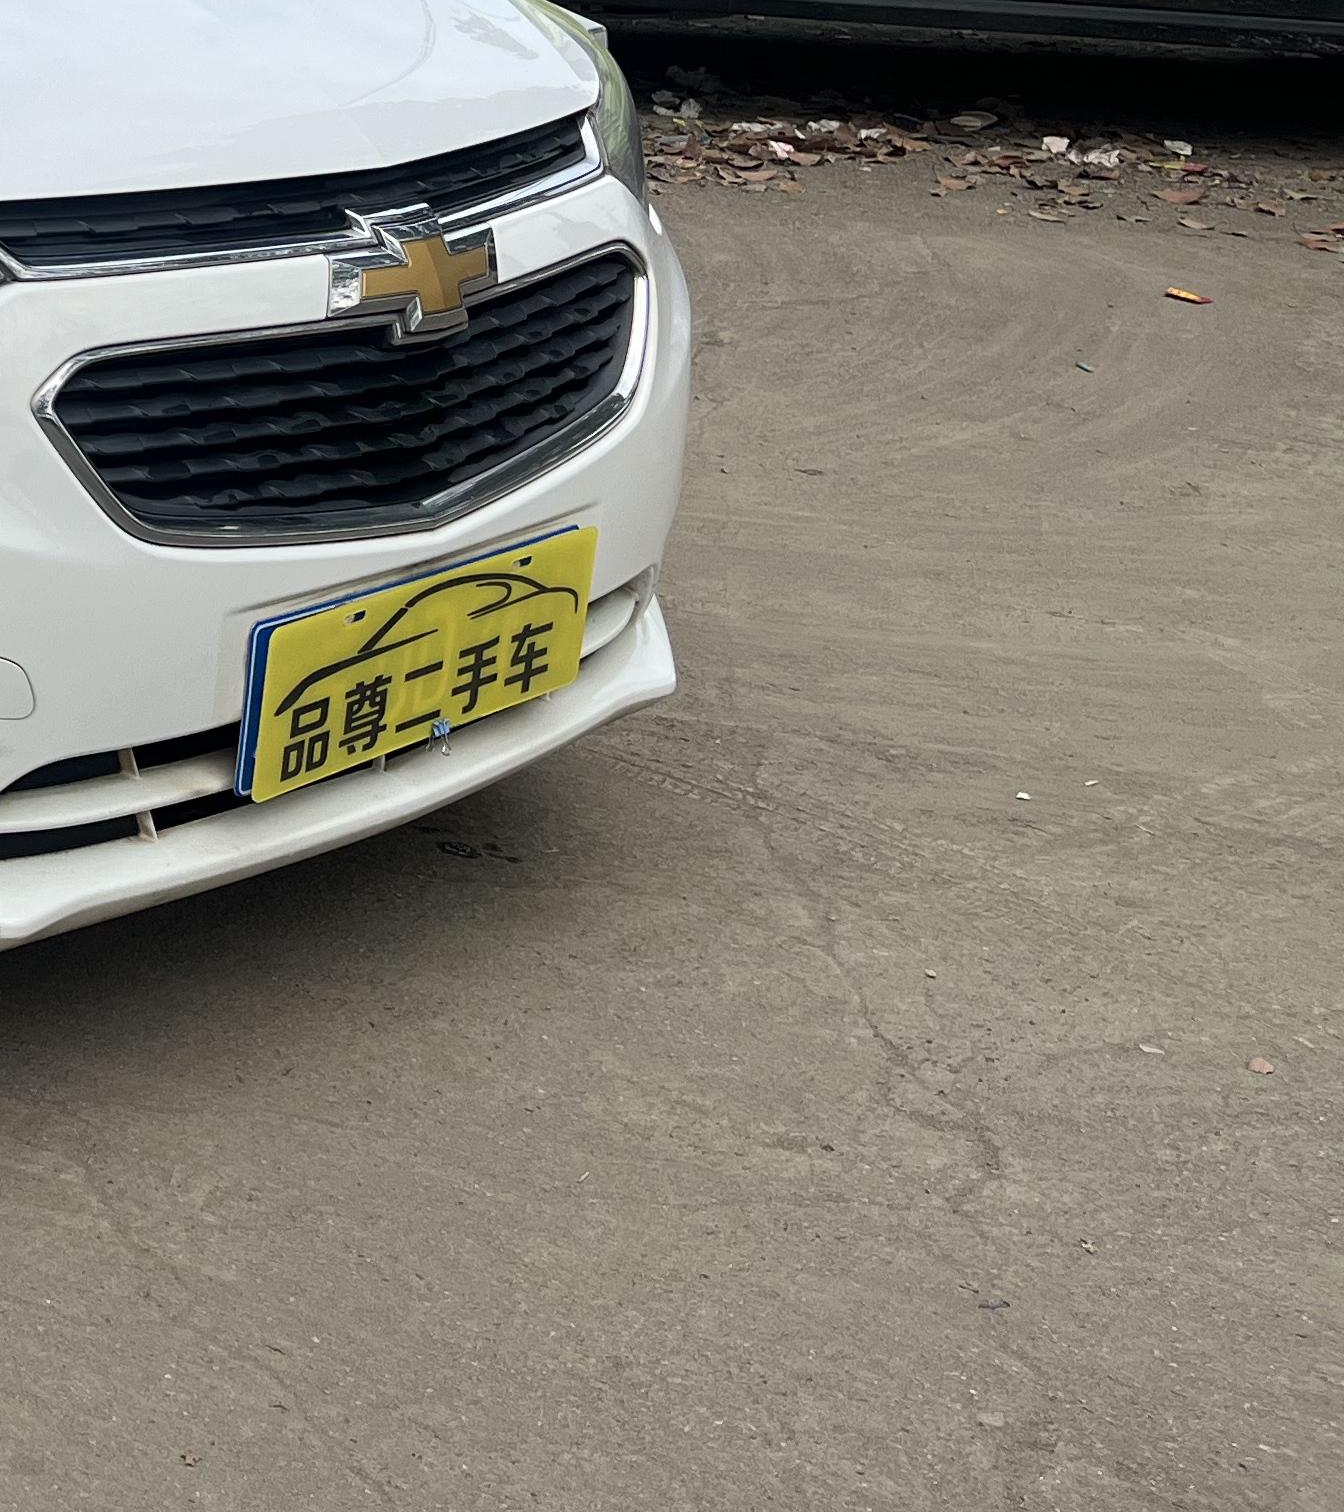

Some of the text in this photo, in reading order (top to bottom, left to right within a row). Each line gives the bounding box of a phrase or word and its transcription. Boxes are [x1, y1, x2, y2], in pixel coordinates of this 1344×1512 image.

[279, 621, 555, 783] 品尊二手车
